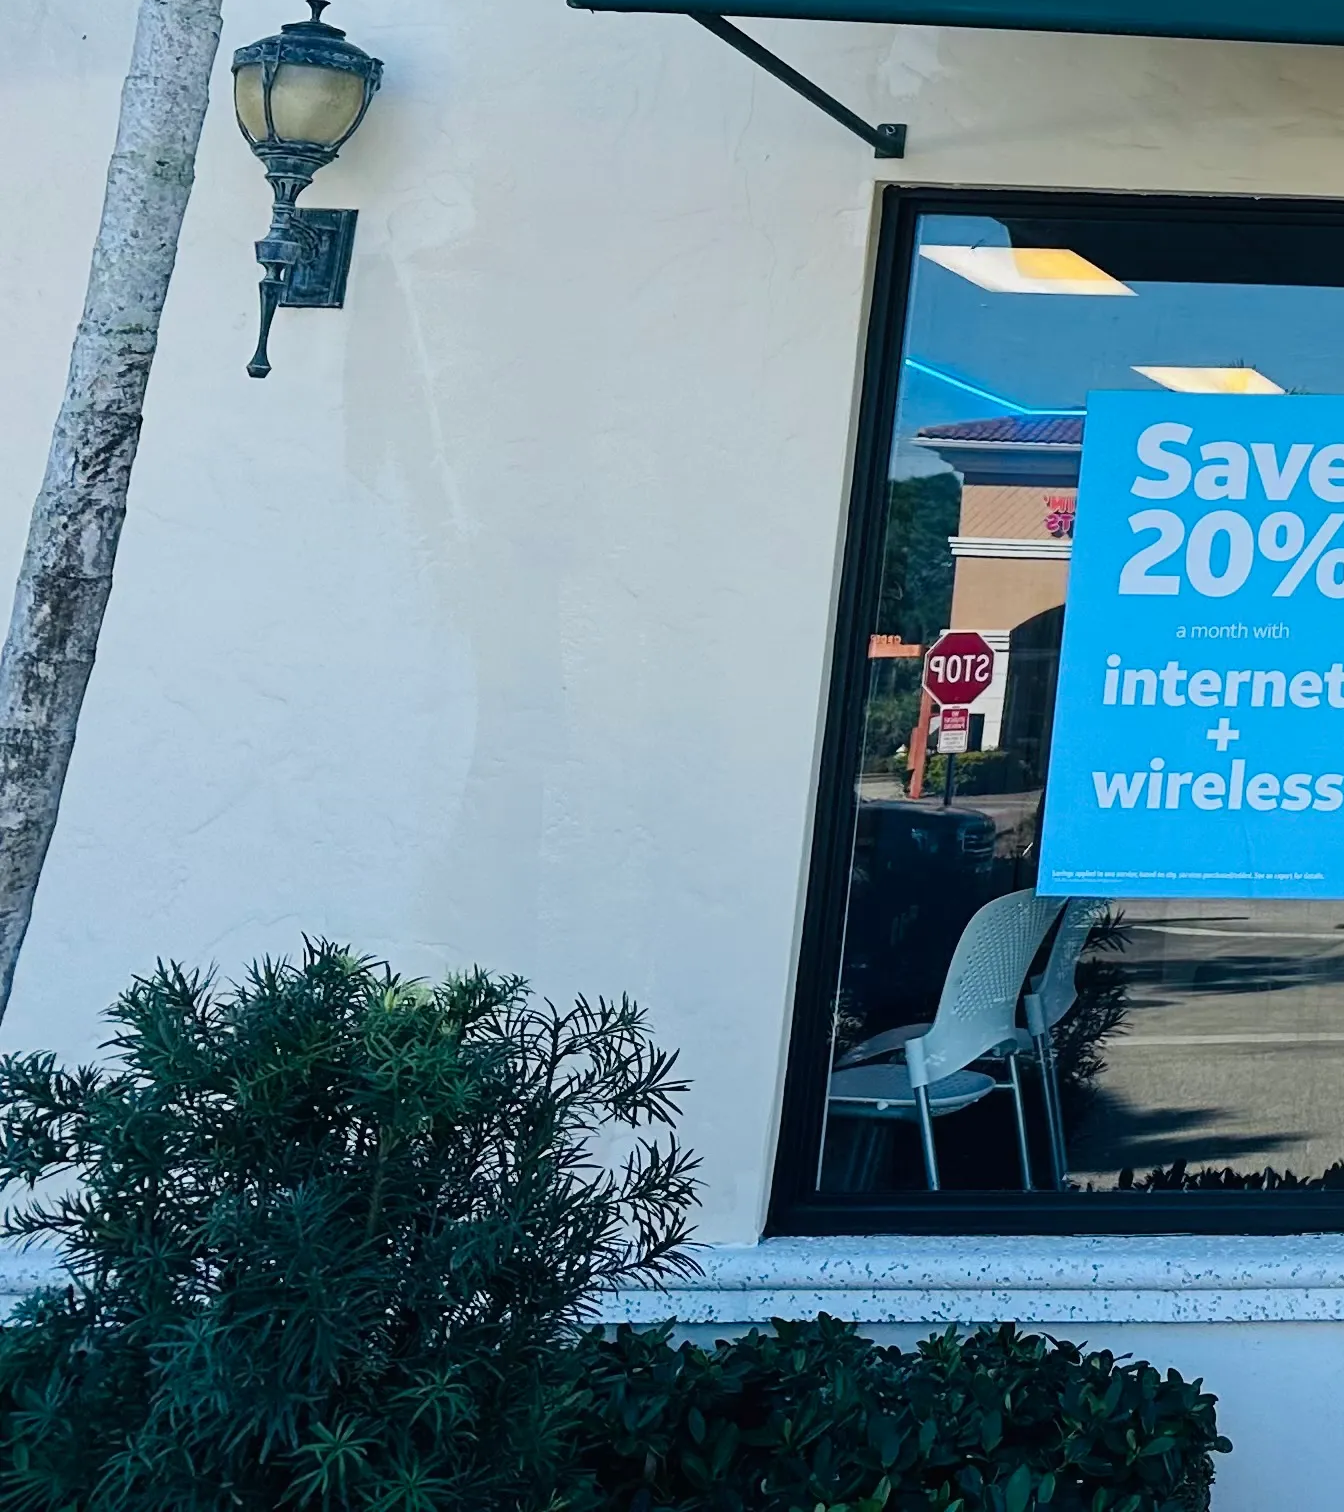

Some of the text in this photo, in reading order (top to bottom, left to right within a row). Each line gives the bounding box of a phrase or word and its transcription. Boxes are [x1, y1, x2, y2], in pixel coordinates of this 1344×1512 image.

[1176, 623, 1290, 638] a month with
[1091, 757, 1344, 810] wireless
